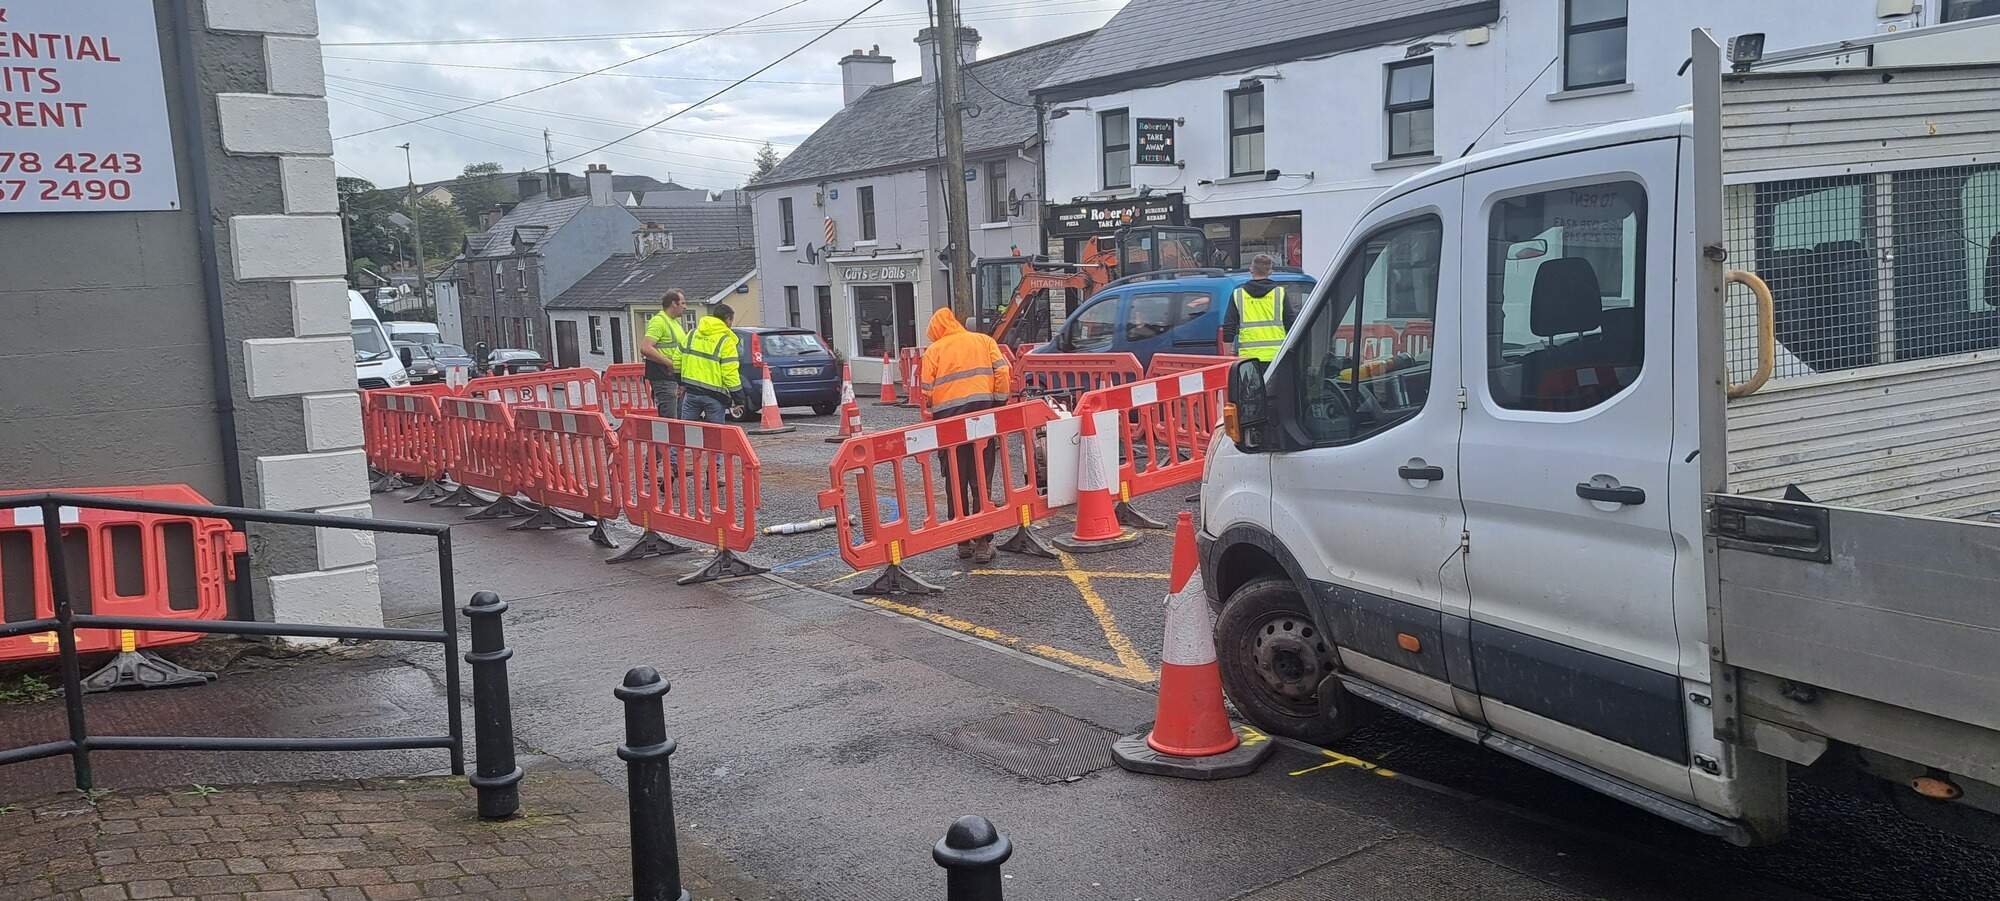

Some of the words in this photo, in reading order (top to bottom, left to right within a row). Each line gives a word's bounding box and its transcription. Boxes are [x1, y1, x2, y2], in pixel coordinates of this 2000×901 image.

[3, 66, 61, 94] ITS
[0, 101, 88, 128] RENT
[1140, 122, 1172, 131] Roberto's
[1146, 133, 1164, 141] TAKE
[0, 152, 42, 174] 78
[54, 153, 142, 174] 4243
[38, 179, 131, 201] 2490
[1098, 220, 1113, 228] TAKE
[1031, 280, 1063, 288] HITACHI
